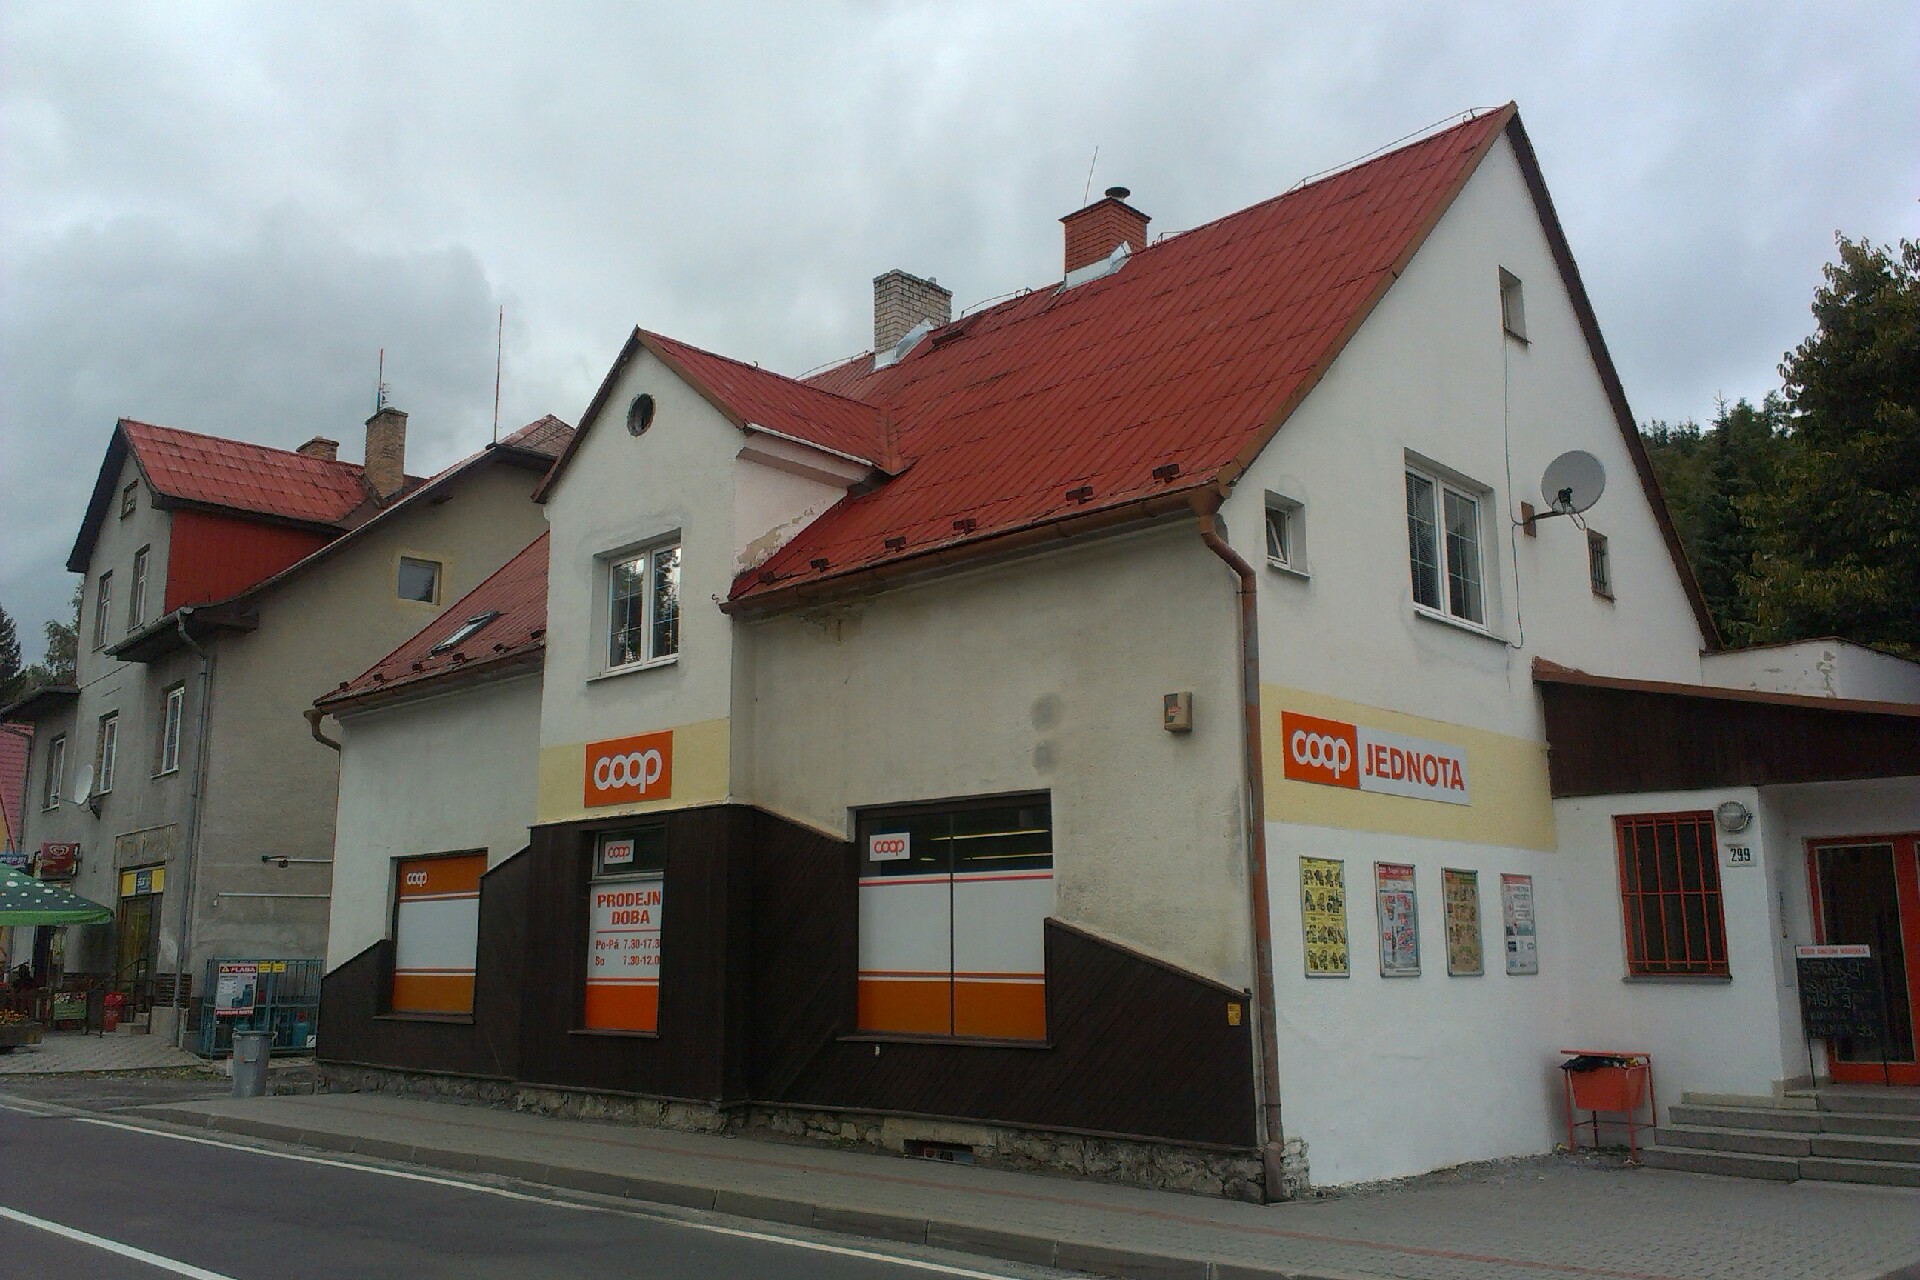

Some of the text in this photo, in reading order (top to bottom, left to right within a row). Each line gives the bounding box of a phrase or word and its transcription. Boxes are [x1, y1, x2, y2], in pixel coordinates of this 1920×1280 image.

[1292, 729, 1466, 791] coop JEDNOTA
[593, 748, 663, 794] coop
[607, 844, 631, 861] coop
[873, 838, 905, 856] coop
[1730, 847, 1751, 862] 299
[406, 871, 428, 888] coop
[611, 910, 651, 925] DOBA
